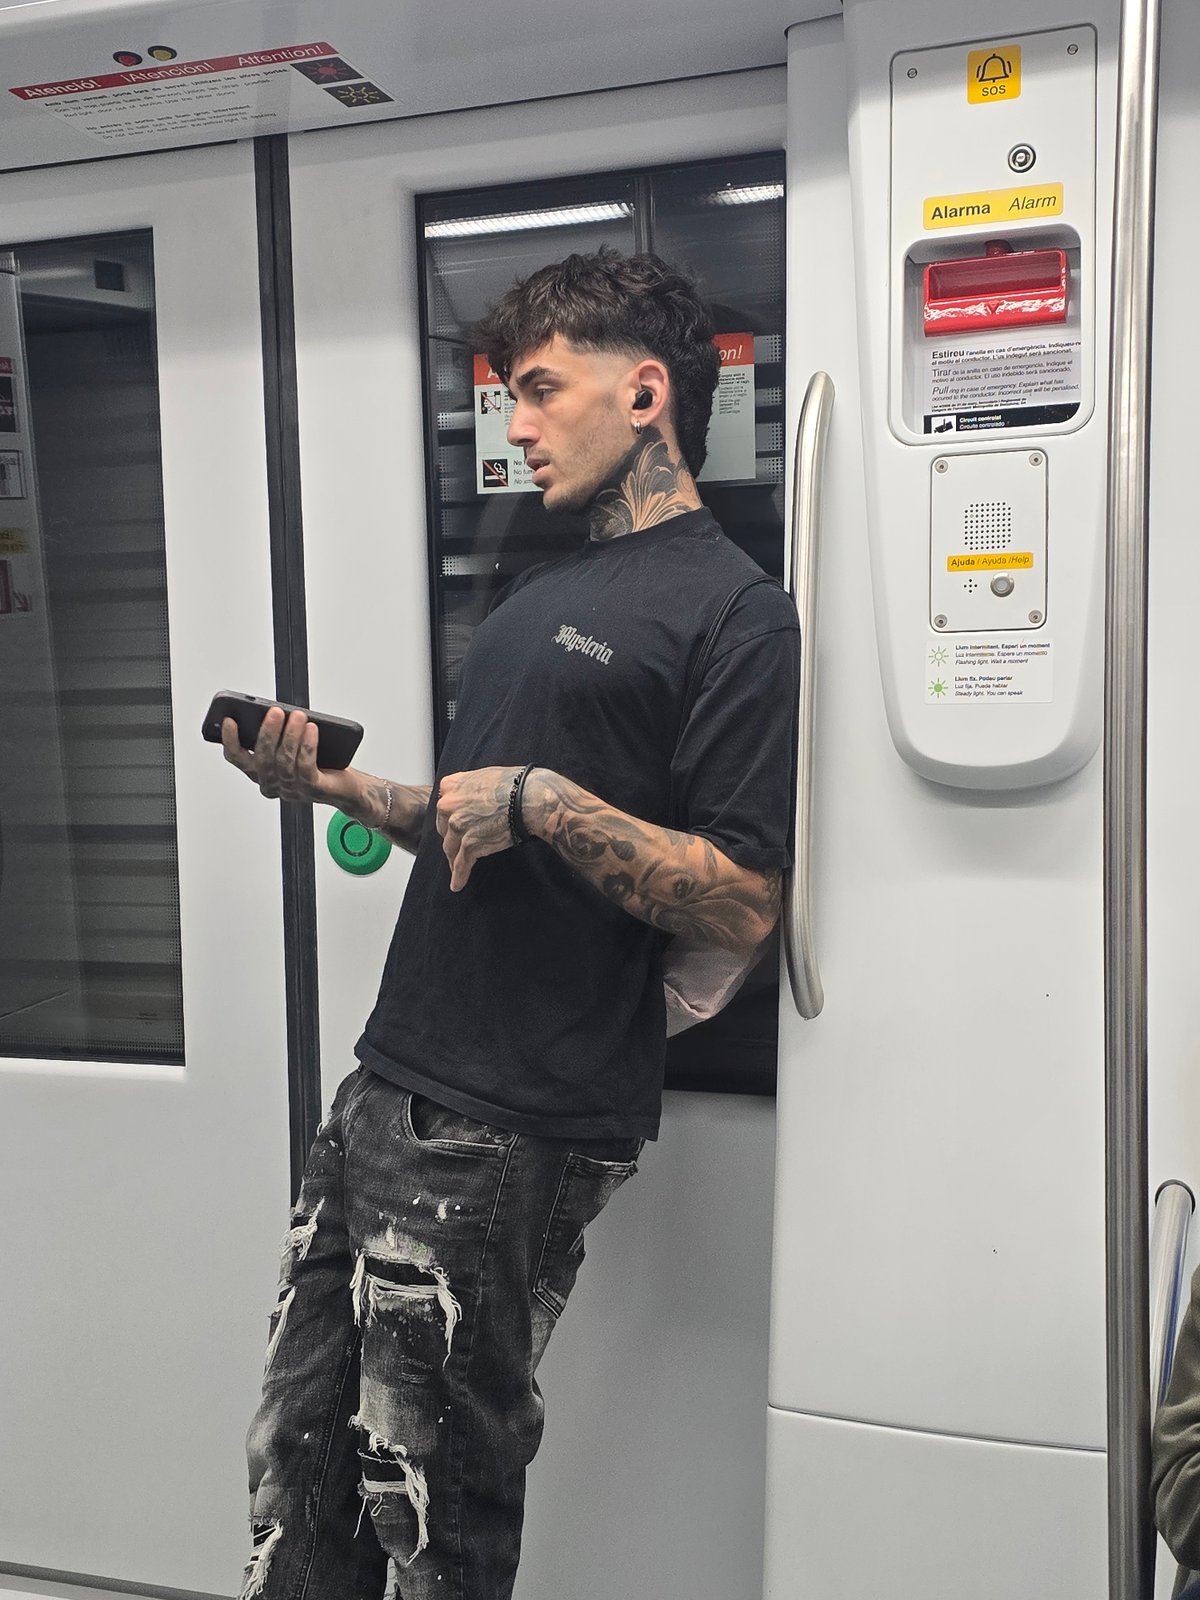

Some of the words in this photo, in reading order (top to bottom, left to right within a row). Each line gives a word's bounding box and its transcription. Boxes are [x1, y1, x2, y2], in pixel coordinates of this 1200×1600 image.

[24, 79, 102, 98] Atenció!
[120, 62, 215, 83] ¡Atención!
[237, 45, 324, 67] Attention!
[981, 84, 1007, 97] SOS
[931, 202, 991, 221] Alarma
[1008, 194, 1057, 212] Alarm
[932, 350, 965, 359] Estireu
[932, 385, 949, 395] Pull
[951, 558, 975, 568] Ajuda
[981, 557, 1007, 566] Ayuda
